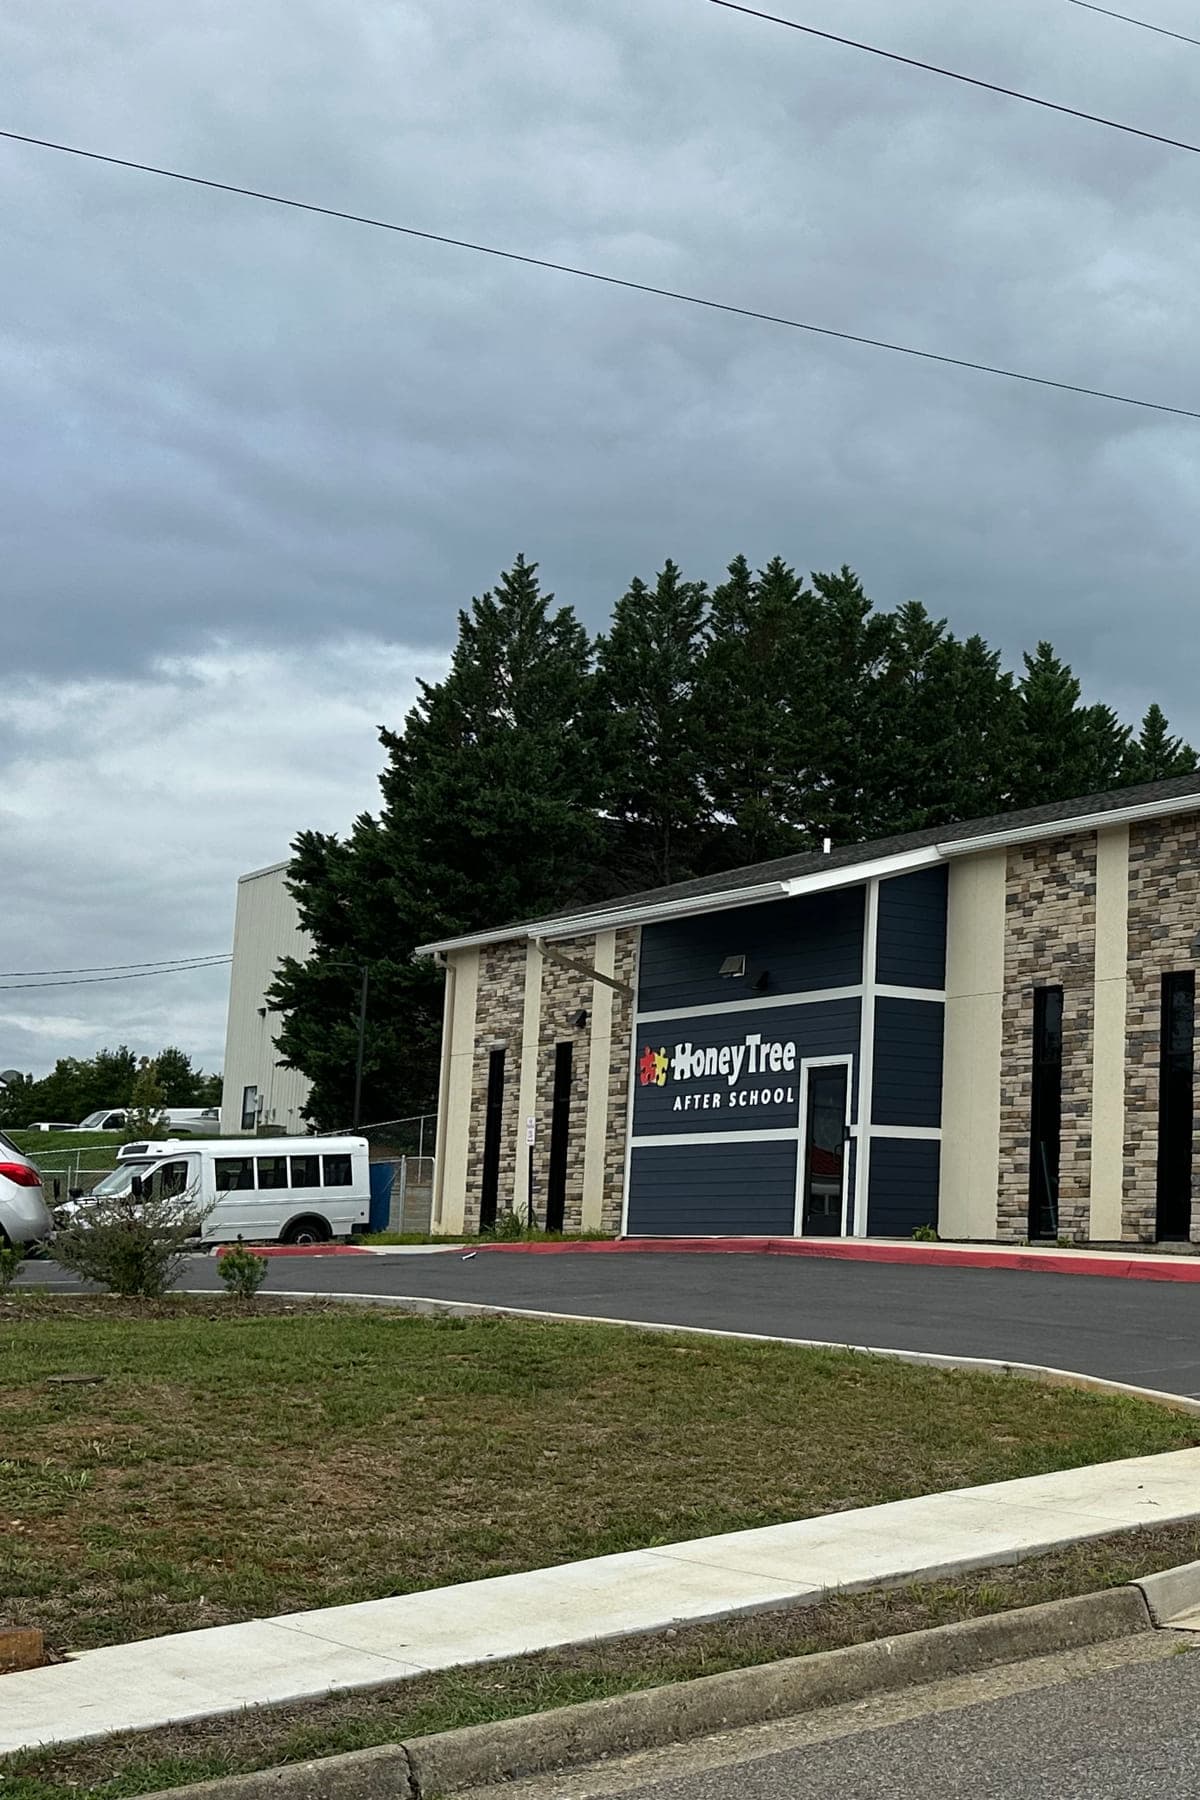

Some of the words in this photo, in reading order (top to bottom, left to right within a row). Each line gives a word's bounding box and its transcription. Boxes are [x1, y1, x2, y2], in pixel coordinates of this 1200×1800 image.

[670, 1033, 797, 1086] HoneyTree
[673, 1092, 721, 1111] AFTER
[729, 1087, 794, 1108] SCHOOL
